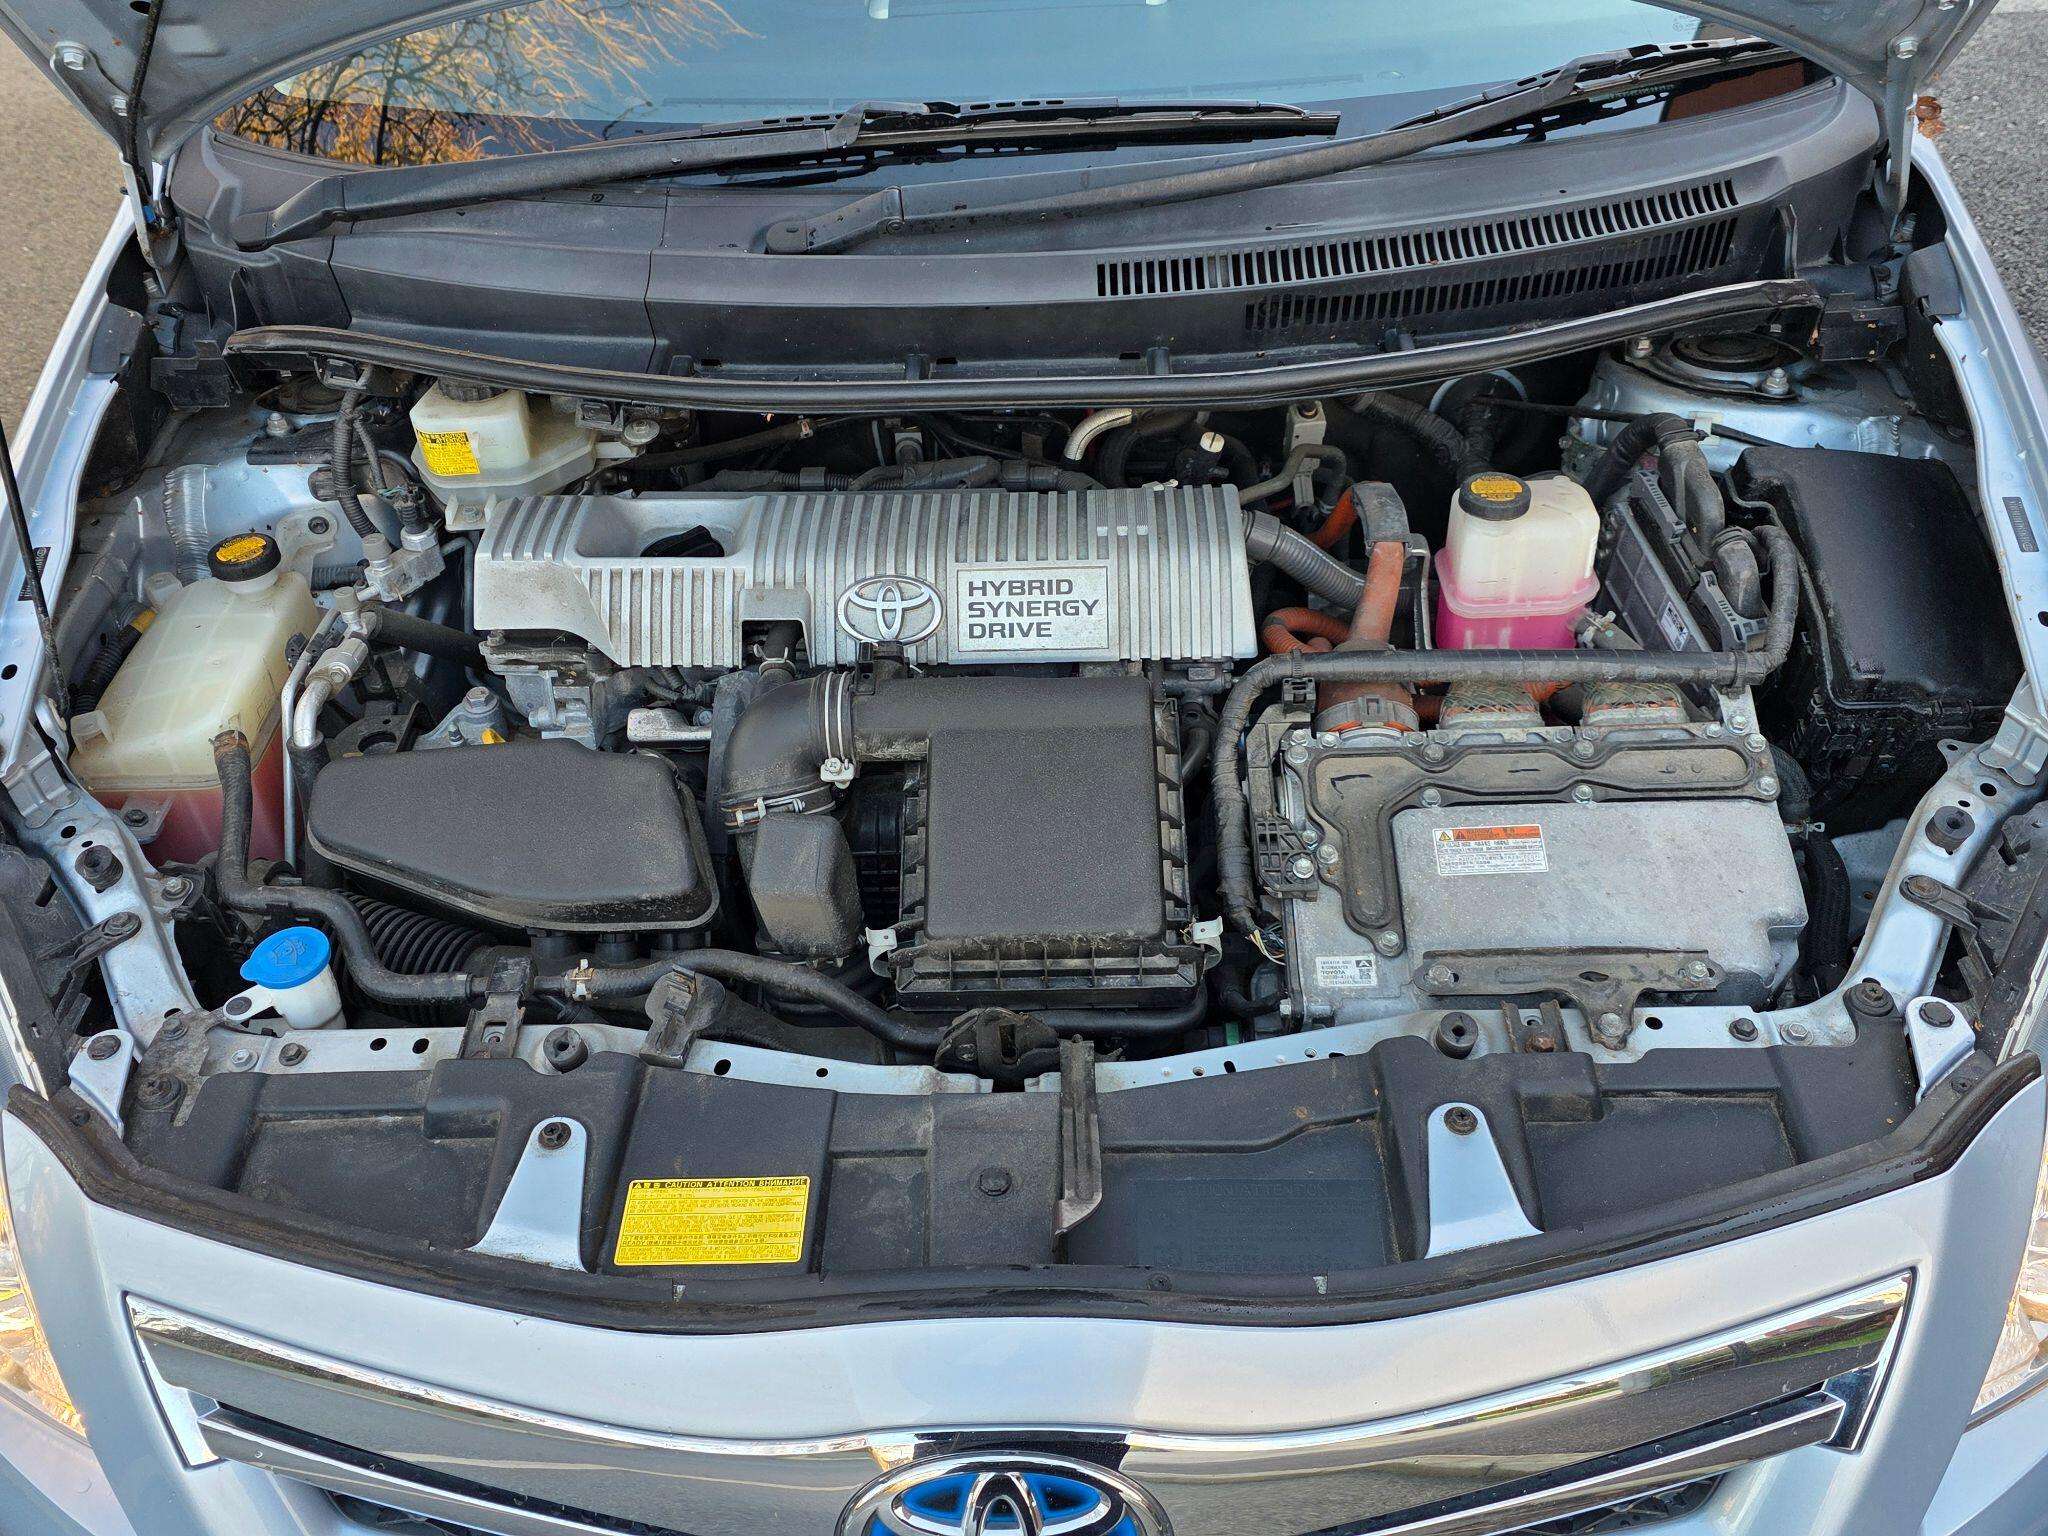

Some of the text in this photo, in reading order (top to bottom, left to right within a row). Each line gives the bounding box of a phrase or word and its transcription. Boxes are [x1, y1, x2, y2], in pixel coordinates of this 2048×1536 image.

[968, 579, 1074, 597] HYBRID
[968, 599, 1100, 618] SYNERGY
[968, 621, 1053, 639] DRIVE
[706, 1179, 755, 1188] ATTENTION
[759, 1178, 806, 1187] ВНИМАНИЕ
